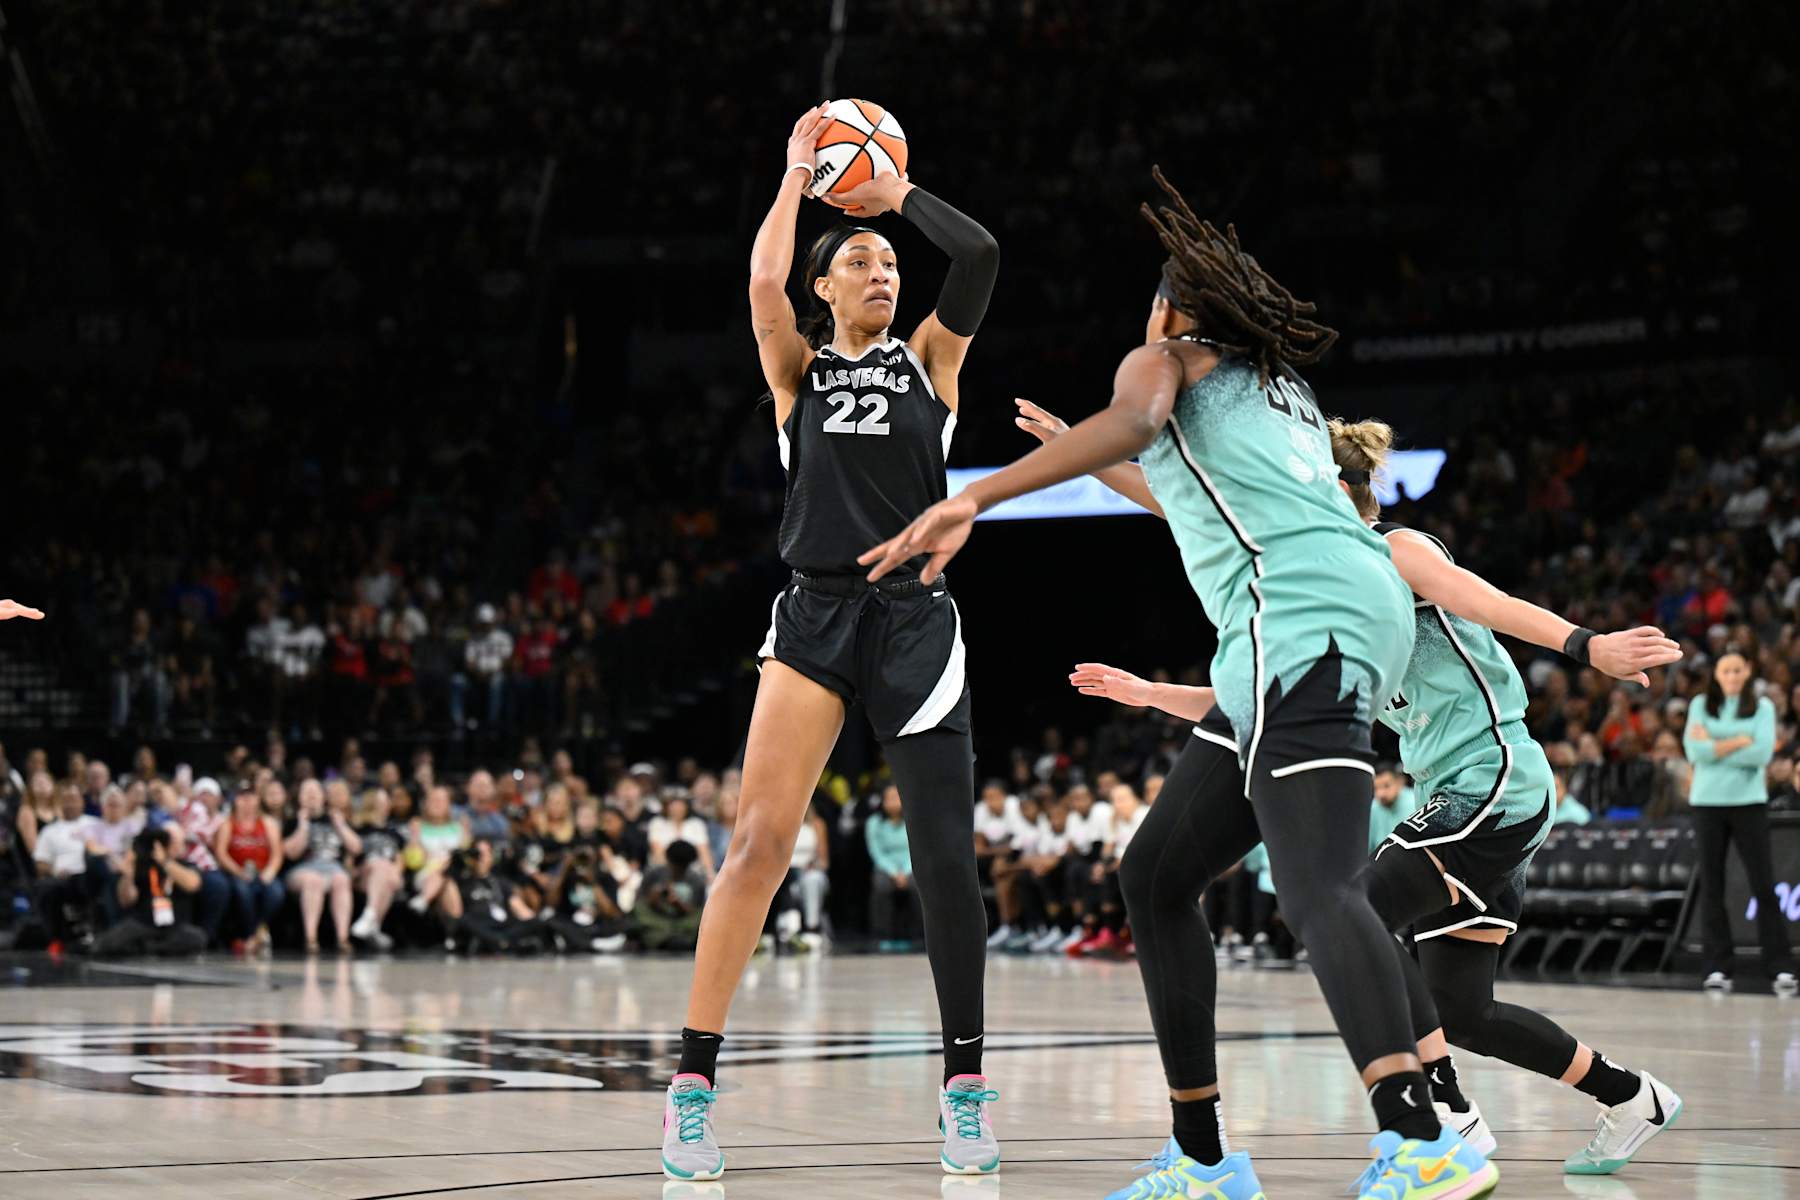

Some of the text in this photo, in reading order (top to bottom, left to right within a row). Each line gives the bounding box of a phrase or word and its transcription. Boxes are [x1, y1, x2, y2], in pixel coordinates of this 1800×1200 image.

[1352, 316, 1647, 362] COMMUNITY CORNER
[812, 367, 911, 394] LAS VEGAS
[823, 391, 890, 435] 22
